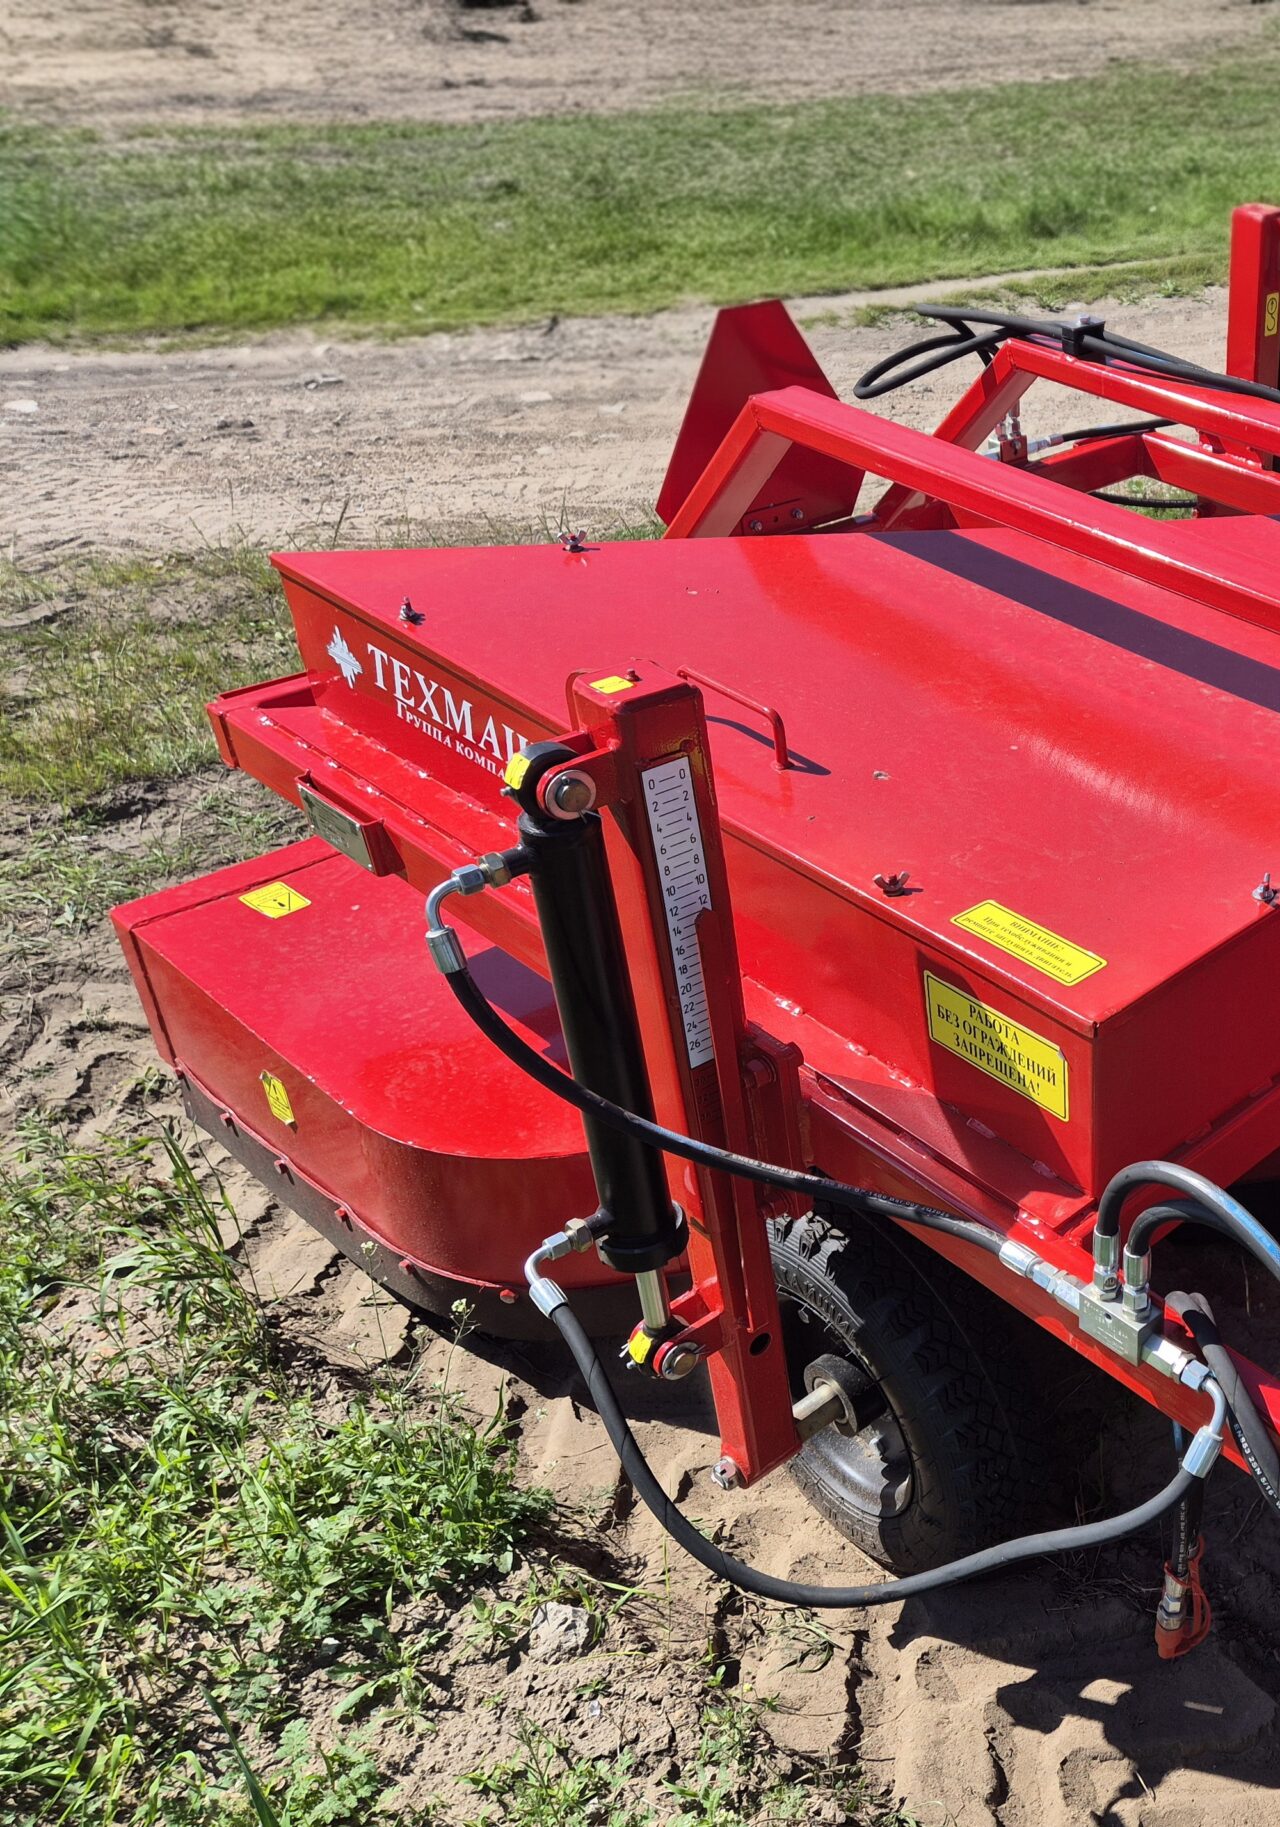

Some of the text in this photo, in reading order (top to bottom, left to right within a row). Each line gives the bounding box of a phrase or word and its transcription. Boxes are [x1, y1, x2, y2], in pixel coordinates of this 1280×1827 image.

[455, 739, 506, 778] КОМПА
[648, 768, 686, 790] 0 0
[652, 790, 689, 813] 2 2
[656, 812, 692, 833] 4 4
[660, 833, 697, 855] 6 6
[664, 853, 700, 876] 8 8
[665, 873, 705, 897] 10 10
[669, 894, 708, 917] 12 12
[672, 926, 682, 937] 14
[675, 945, 685, 956] 16
[678, 964, 688, 976] 18
[680, 982, 692, 995] 20
[683, 1001, 695, 1014] 22
[686, 1021, 698, 1033] 24
[969, 1004, 1020, 1046] РАБОТА
[689, 1039, 701, 1052] 26
[936, 1004, 1056, 1086] БЕЗ ОГРАЖДЕНИЙ
[953, 1033, 1040, 1096] ЗАПРЕЩЕНА!
[1248, 1456, 1263, 1475] 2SN
